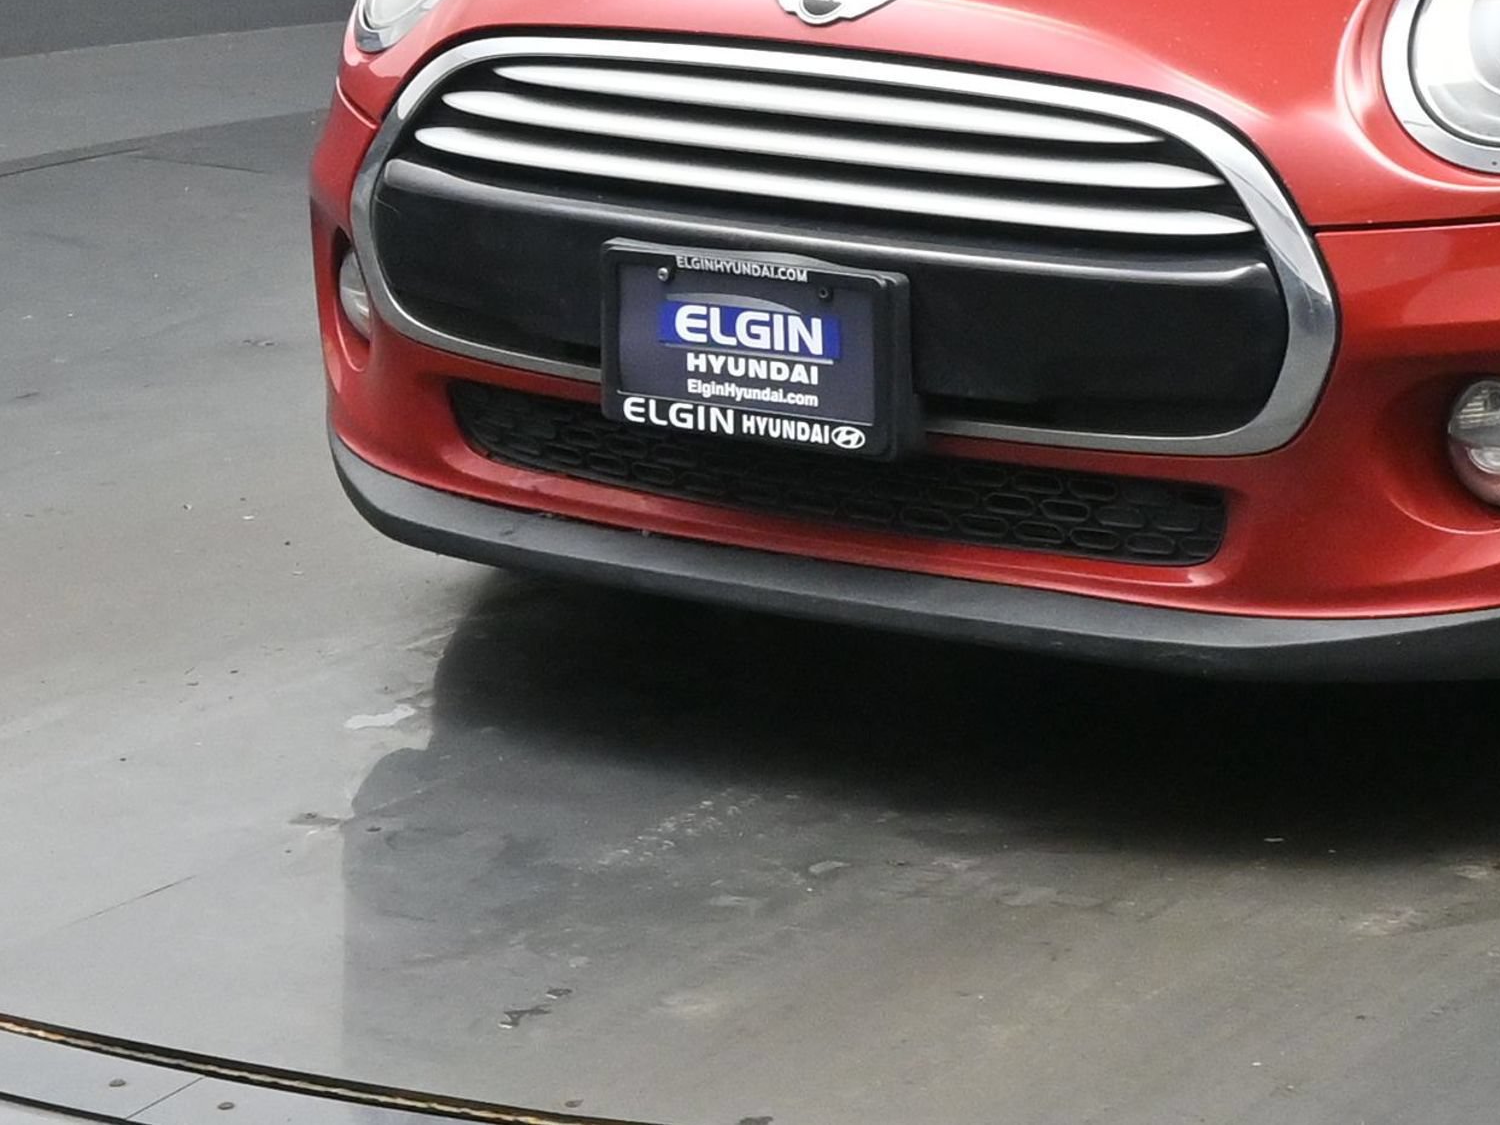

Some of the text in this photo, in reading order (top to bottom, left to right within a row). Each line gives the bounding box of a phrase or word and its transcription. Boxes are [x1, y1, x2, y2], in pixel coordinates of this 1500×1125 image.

[676, 255, 808, 283] ELGINHYUNDAI.COM
[675, 305, 823, 355] ELGIN
[686, 353, 819, 385] HYUNDAI
[687, 379, 819, 407] ElginHyundai.com
[623, 397, 829, 444] ELGIN HYUNDAI
